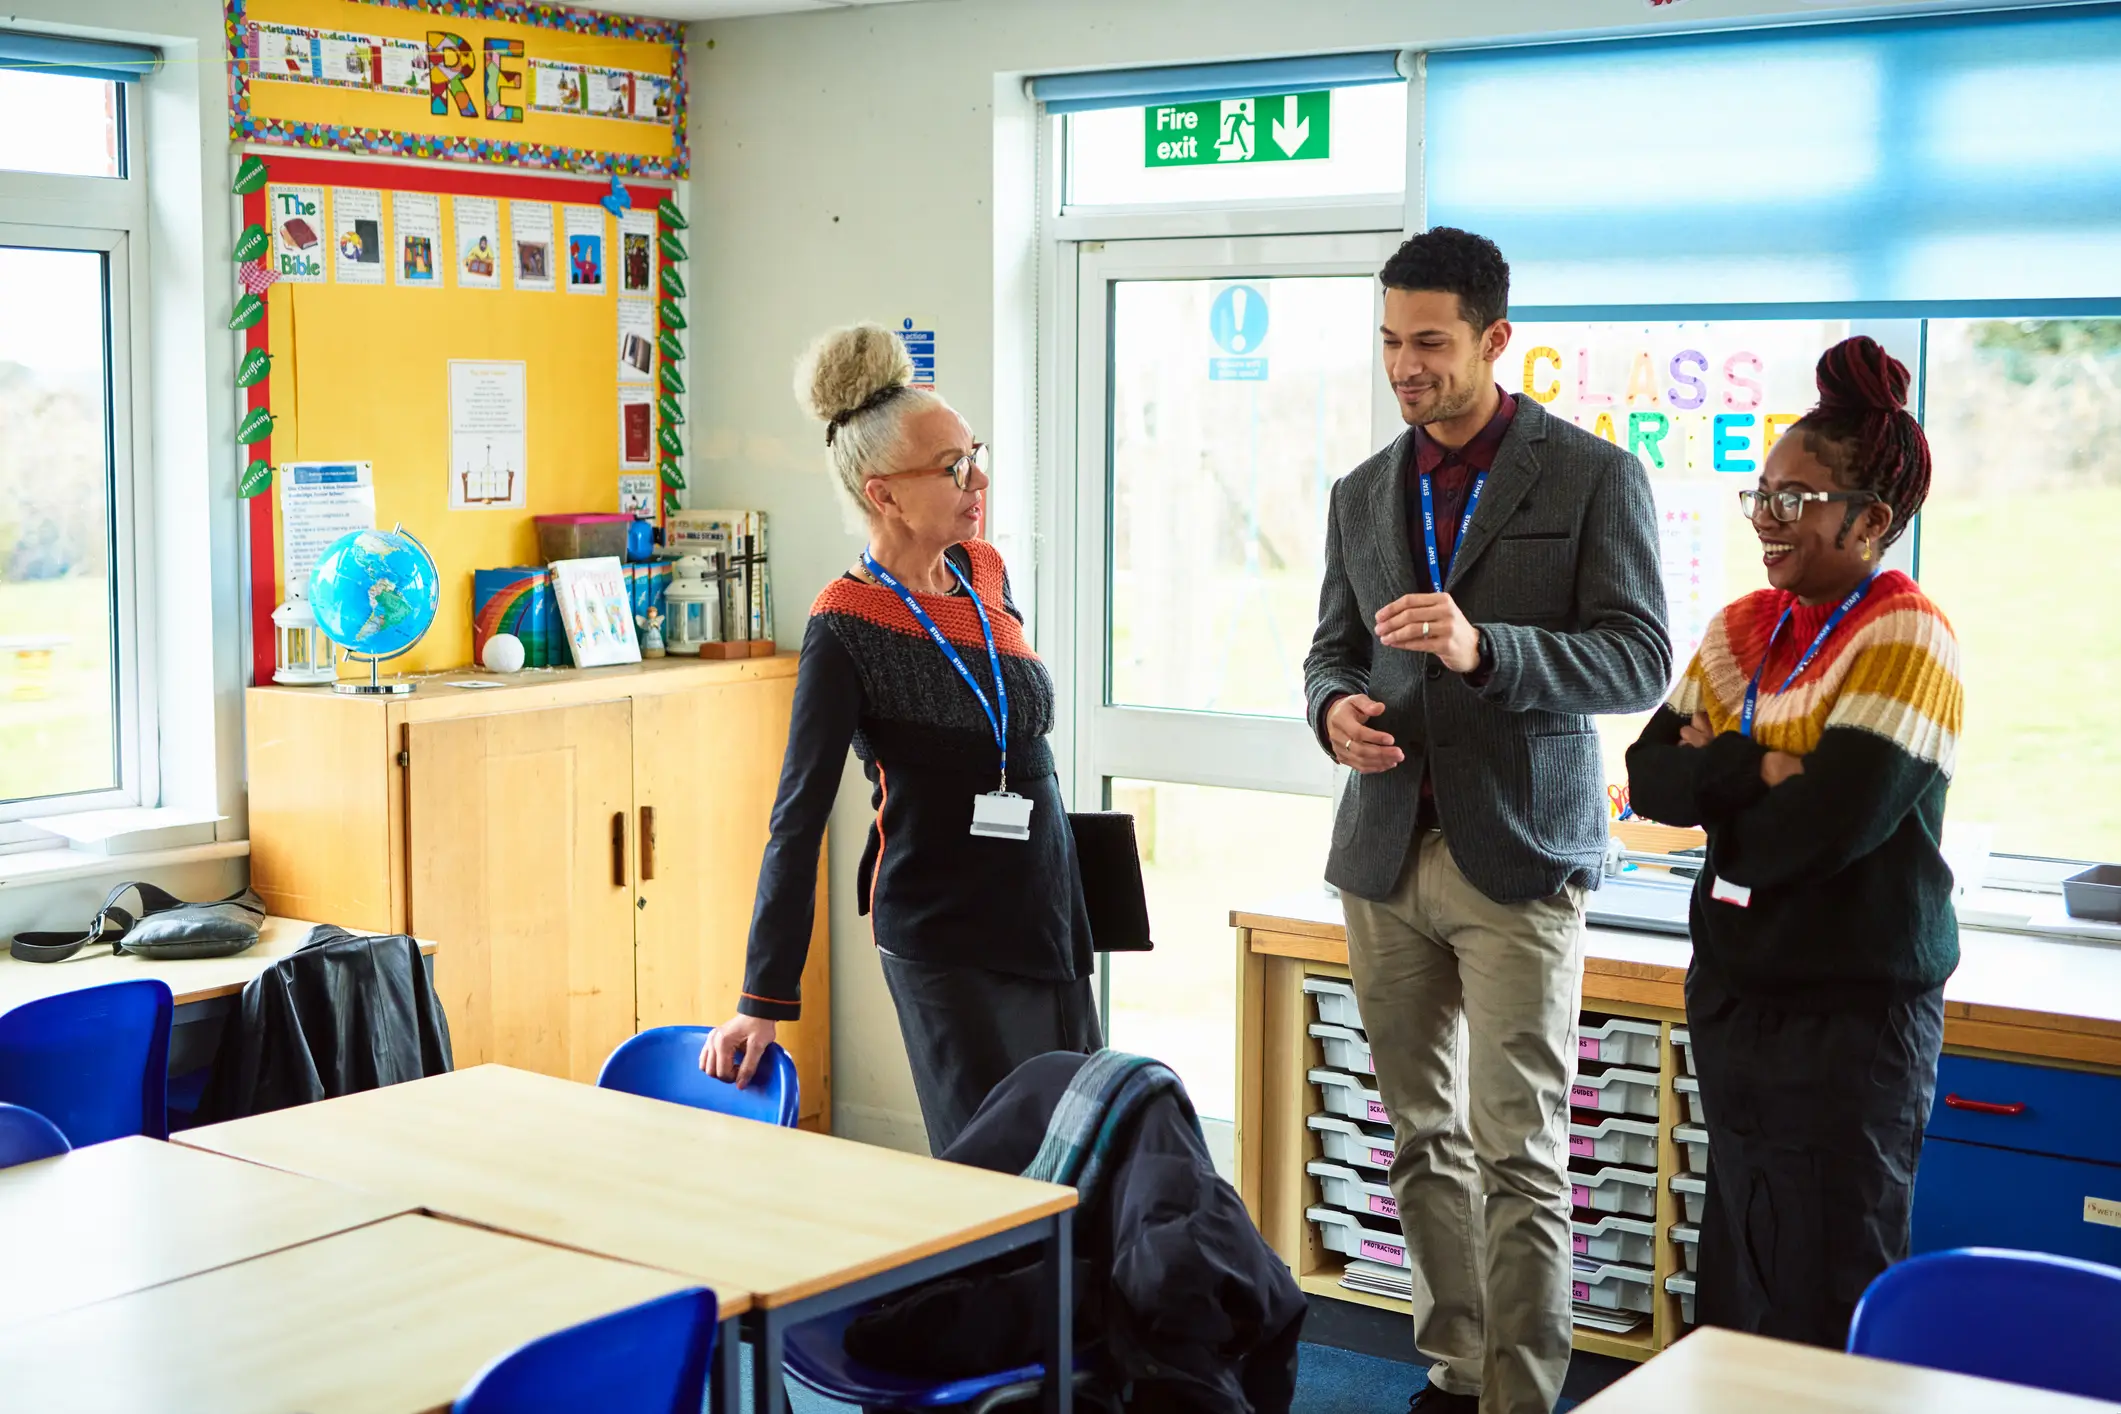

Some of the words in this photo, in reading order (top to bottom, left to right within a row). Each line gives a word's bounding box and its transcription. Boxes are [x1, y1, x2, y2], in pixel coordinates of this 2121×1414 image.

[249, 22, 310, 40] Christianity
[310, 30, 371, 44] Judaism
[381, 38, 419, 50] Islam
[426, 30, 524, 123] RE
[1157, 108, 1198, 131] Fire
[1157, 136, 1198, 160] exit
[278, 193, 316, 216] The
[237, 233, 262, 258] service
[280, 254, 320, 276] Bible
[229, 300, 261, 329] compassion
[238, 356, 265, 386] sacrifice
[1522, 346, 1764, 411] CLASS
[237, 413, 270, 444] generosity
[662, 428, 678, 450] love
[240, 467, 269, 496] justice
[662, 463, 683, 484] peace
[1472, 479, 1484, 499] STAFF
[1461, 514, 1472, 534] STAFF
[880, 572, 897, 587] STAFF
[905, 596, 922, 615] STAFF
[1841, 592, 1861, 612] STAFF
[929, 626, 946, 645] STAFF
[1814, 624, 1831, 645] STAFF
[988, 640, 996, 659] STAFF
[952, 657, 968, 675] STAFF
[996, 676, 1004, 696] STAFF
[976, 688, 989, 707] STAFF
[1745, 698, 1754, 720] STAFF
[1572, 1088, 1594, 1097] GUIDES
[1364, 1240, 1401, 1256] PROTRACTORS
